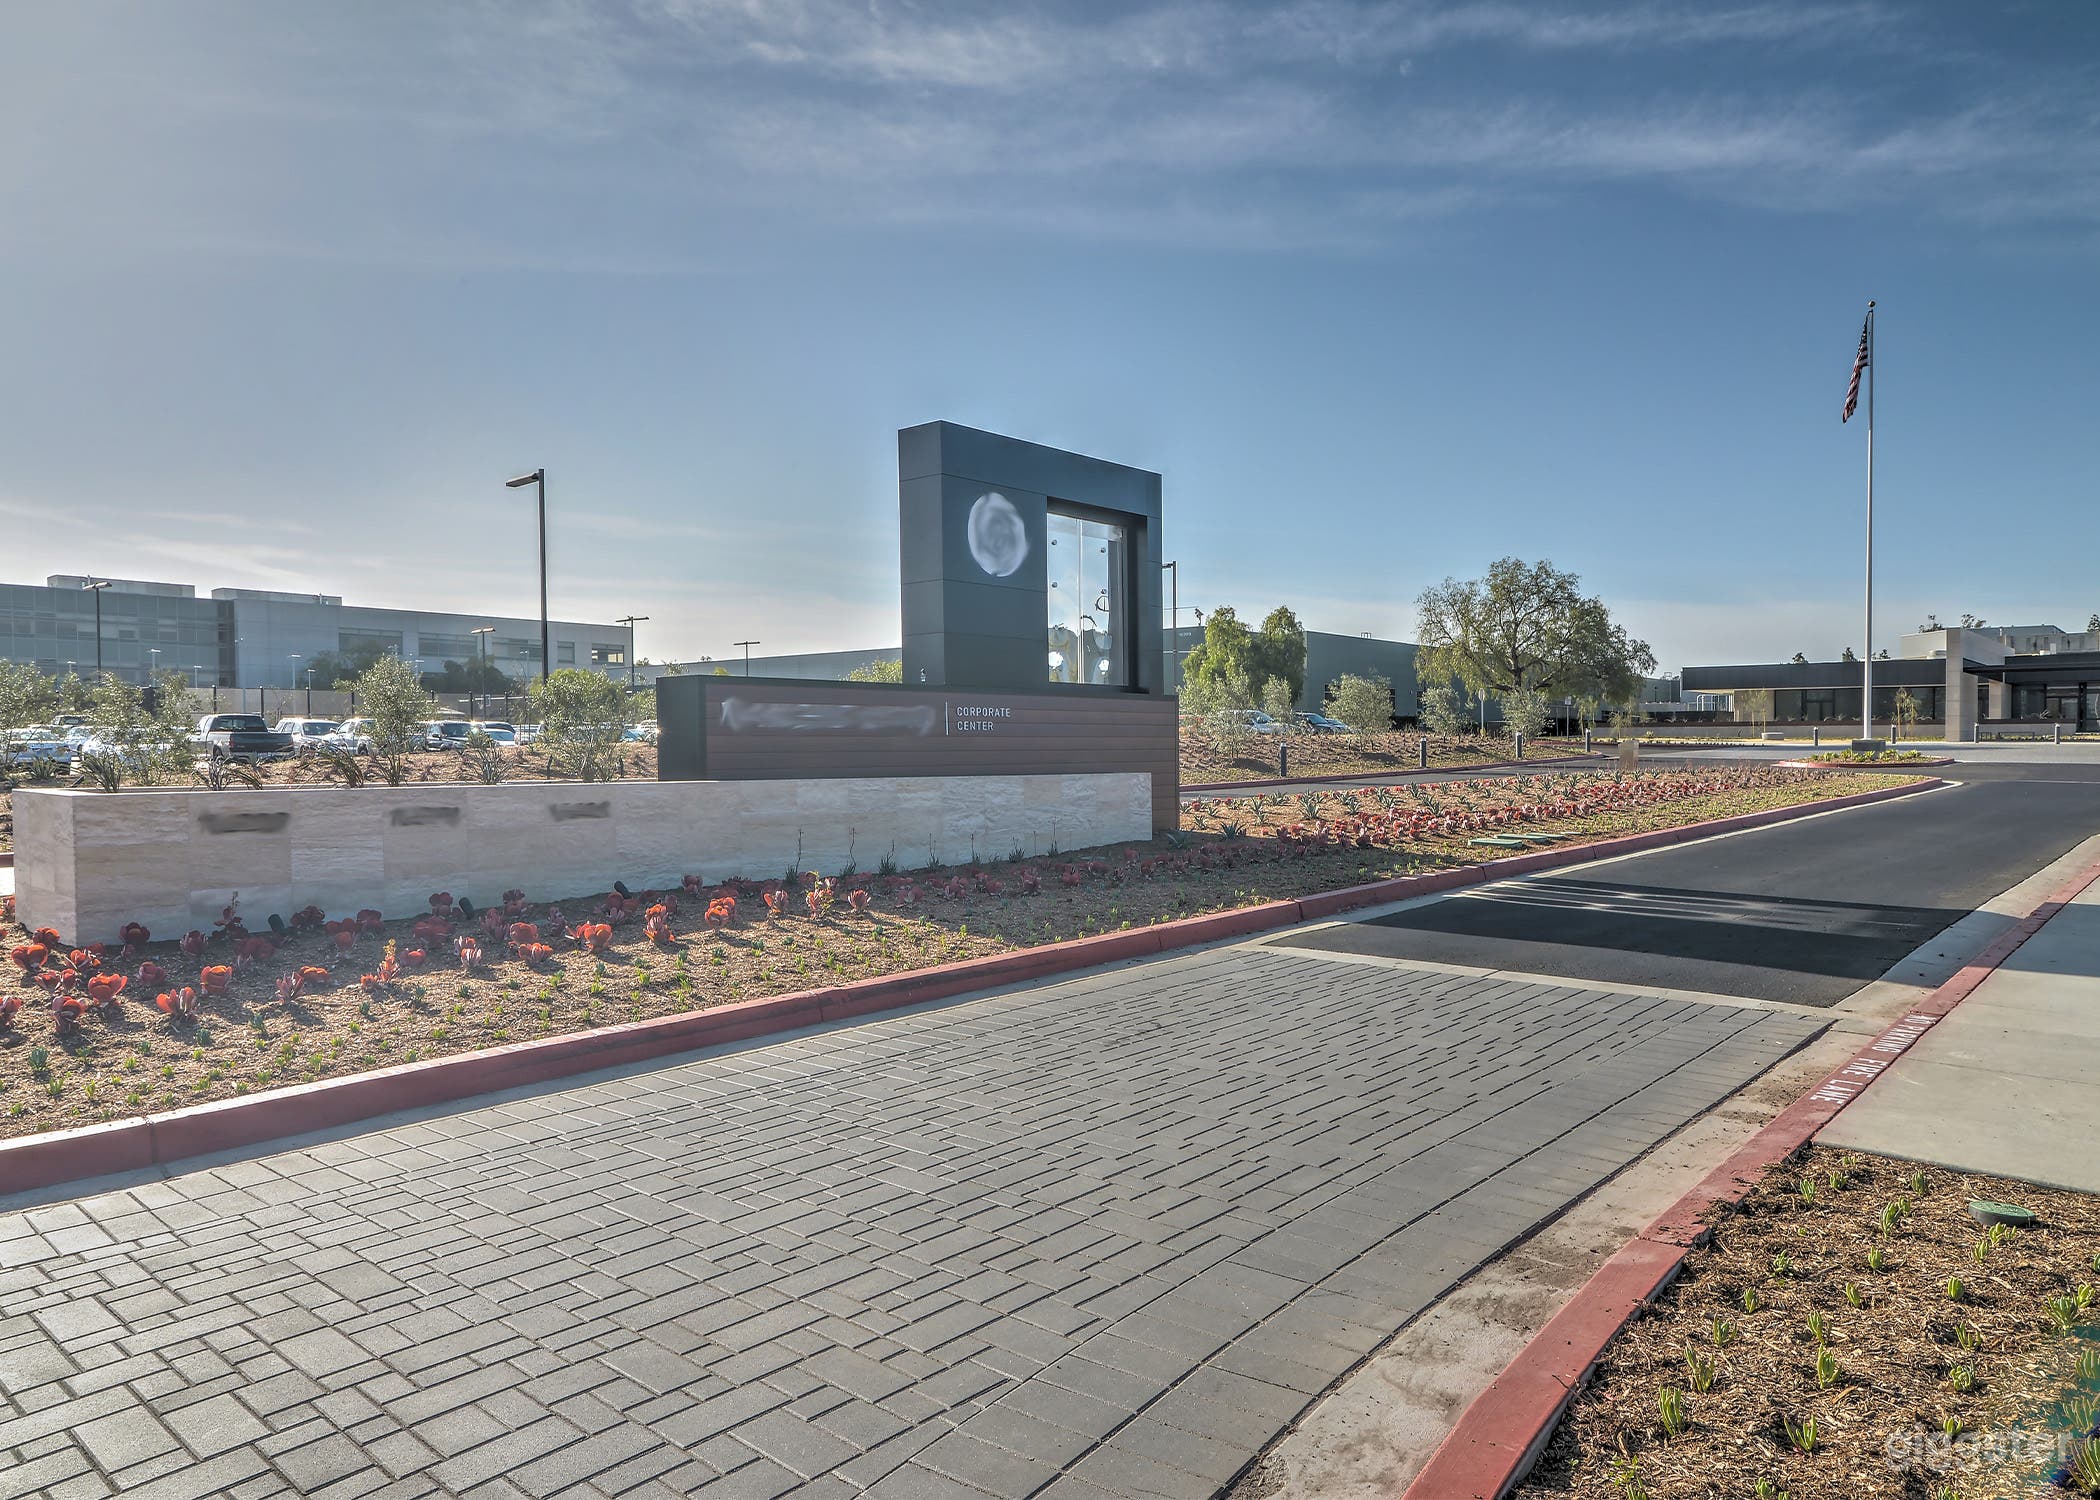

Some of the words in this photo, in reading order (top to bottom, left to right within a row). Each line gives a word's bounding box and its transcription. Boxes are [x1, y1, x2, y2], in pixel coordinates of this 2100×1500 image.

[956, 706, 1011, 717] CORPORATE
[957, 720, 994, 731] CENTER
[1904, 1014, 1938, 1024] NO
[1872, 1024, 1925, 1053] PARKING
[1841, 1057, 1890, 1078] FIRE
[1810, 1079, 1865, 1104] LANE
